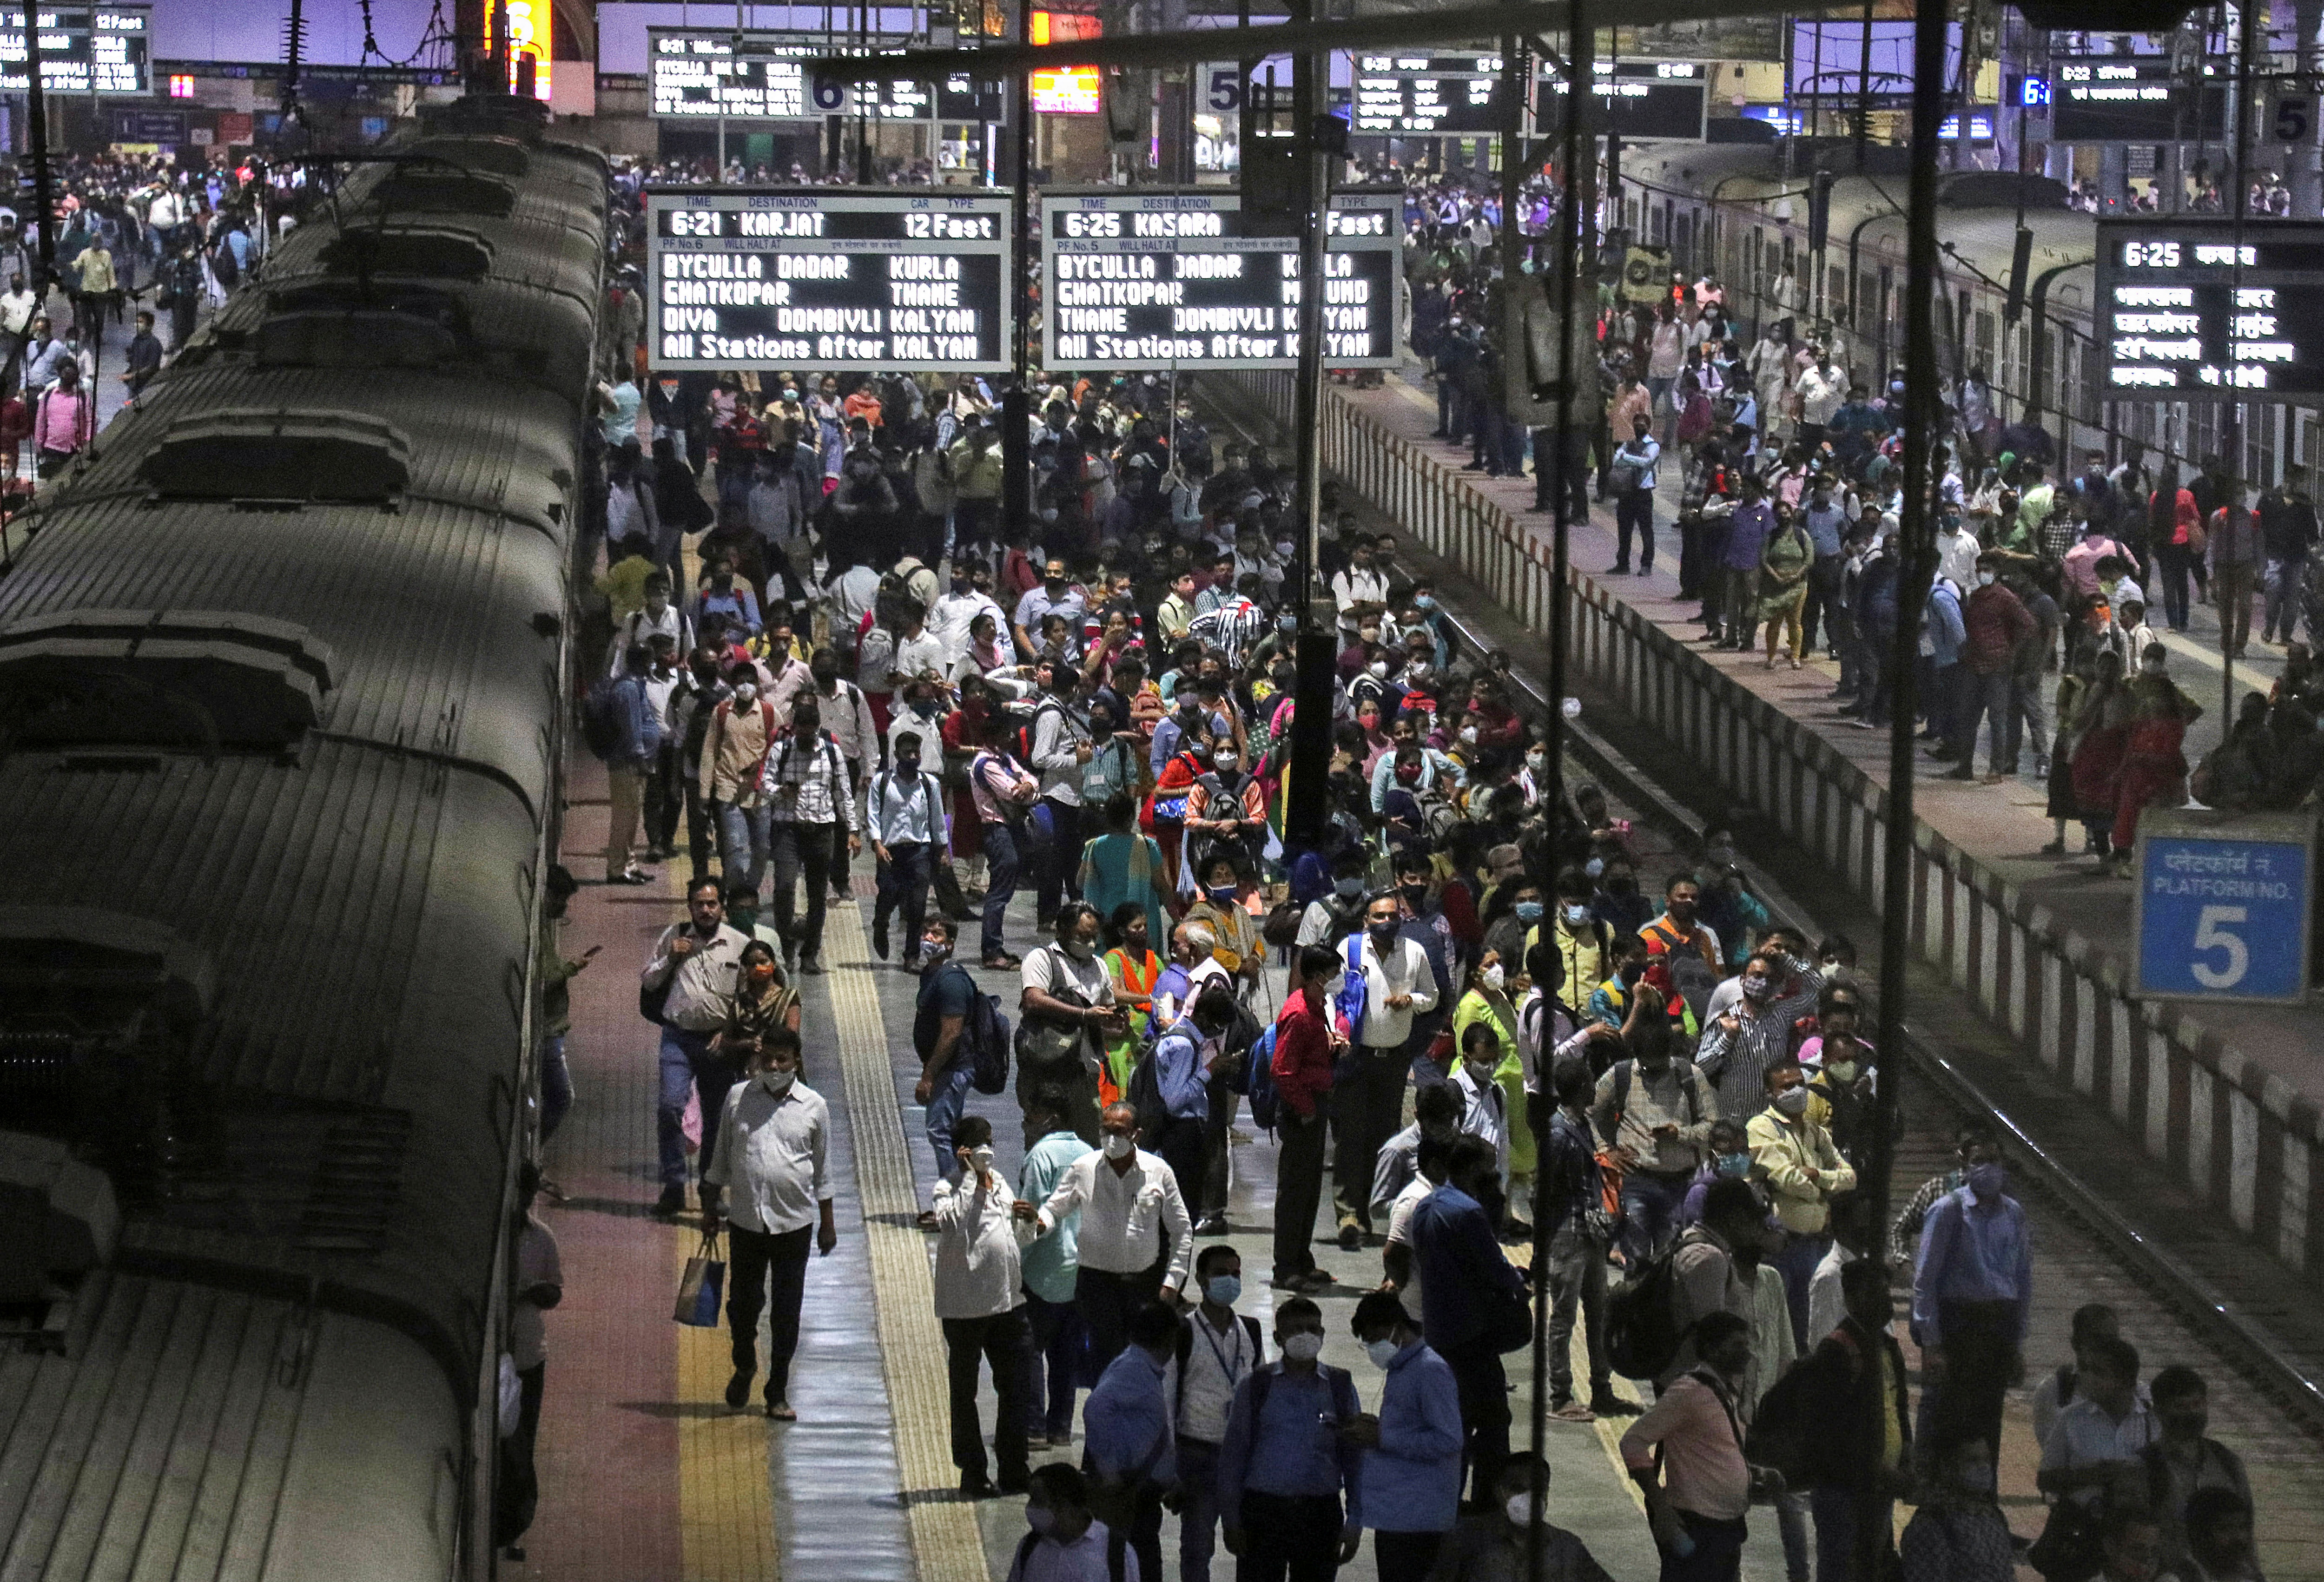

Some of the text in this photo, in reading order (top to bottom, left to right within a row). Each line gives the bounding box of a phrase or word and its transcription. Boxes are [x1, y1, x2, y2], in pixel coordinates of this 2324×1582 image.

[1209, 72, 1240, 111] 5
[2276, 101, 2307, 139] 5
[686, 197, 974, 209] TIME DESTINATION CAR TYPE
[1081, 197, 1367, 208] TIME DESTINATION TYPE
[672, 211, 992, 238] 6:21 KARJAT 12 Fast
[1067, 211, 1383, 237] 6:25 KASARA Fast
[663, 239, 676, 249] PF
[694, 239, 703, 249] 6
[724, 239, 746, 249] WILL
[747, 239, 769, 249] HALT
[769, 239, 781, 249] AT
[1057, 241, 1070, 251] PF
[1073, 241, 1089, 251] No.
[1091, 241, 1099, 251] 5
[1120, 241, 1140, 250] WILL
[1142, 241, 1164, 251] HALT
[2126, 242, 2180, 267] 6:25
[664, 254, 959, 280] BYCULLA DADAR KURLA
[1058, 254, 1352, 279] BYCULLA DADAR KLA
[664, 280, 959, 307] GHATKOPAR THANE
[1059, 280, 1368, 306] GHATKOPAR MUND
[664, 307, 975, 333] DIVA DOMBIVLI KALYAN
[1059, 307, 1367, 332] THANE DOMBIVLI KYAN
[664, 334, 977, 360] All Stations After KALYAN
[1059, 333, 1370, 359] All Stations After KYAN
[2153, 876, 2254, 898] PLATFORM
[2191, 905, 2249, 989] 5
